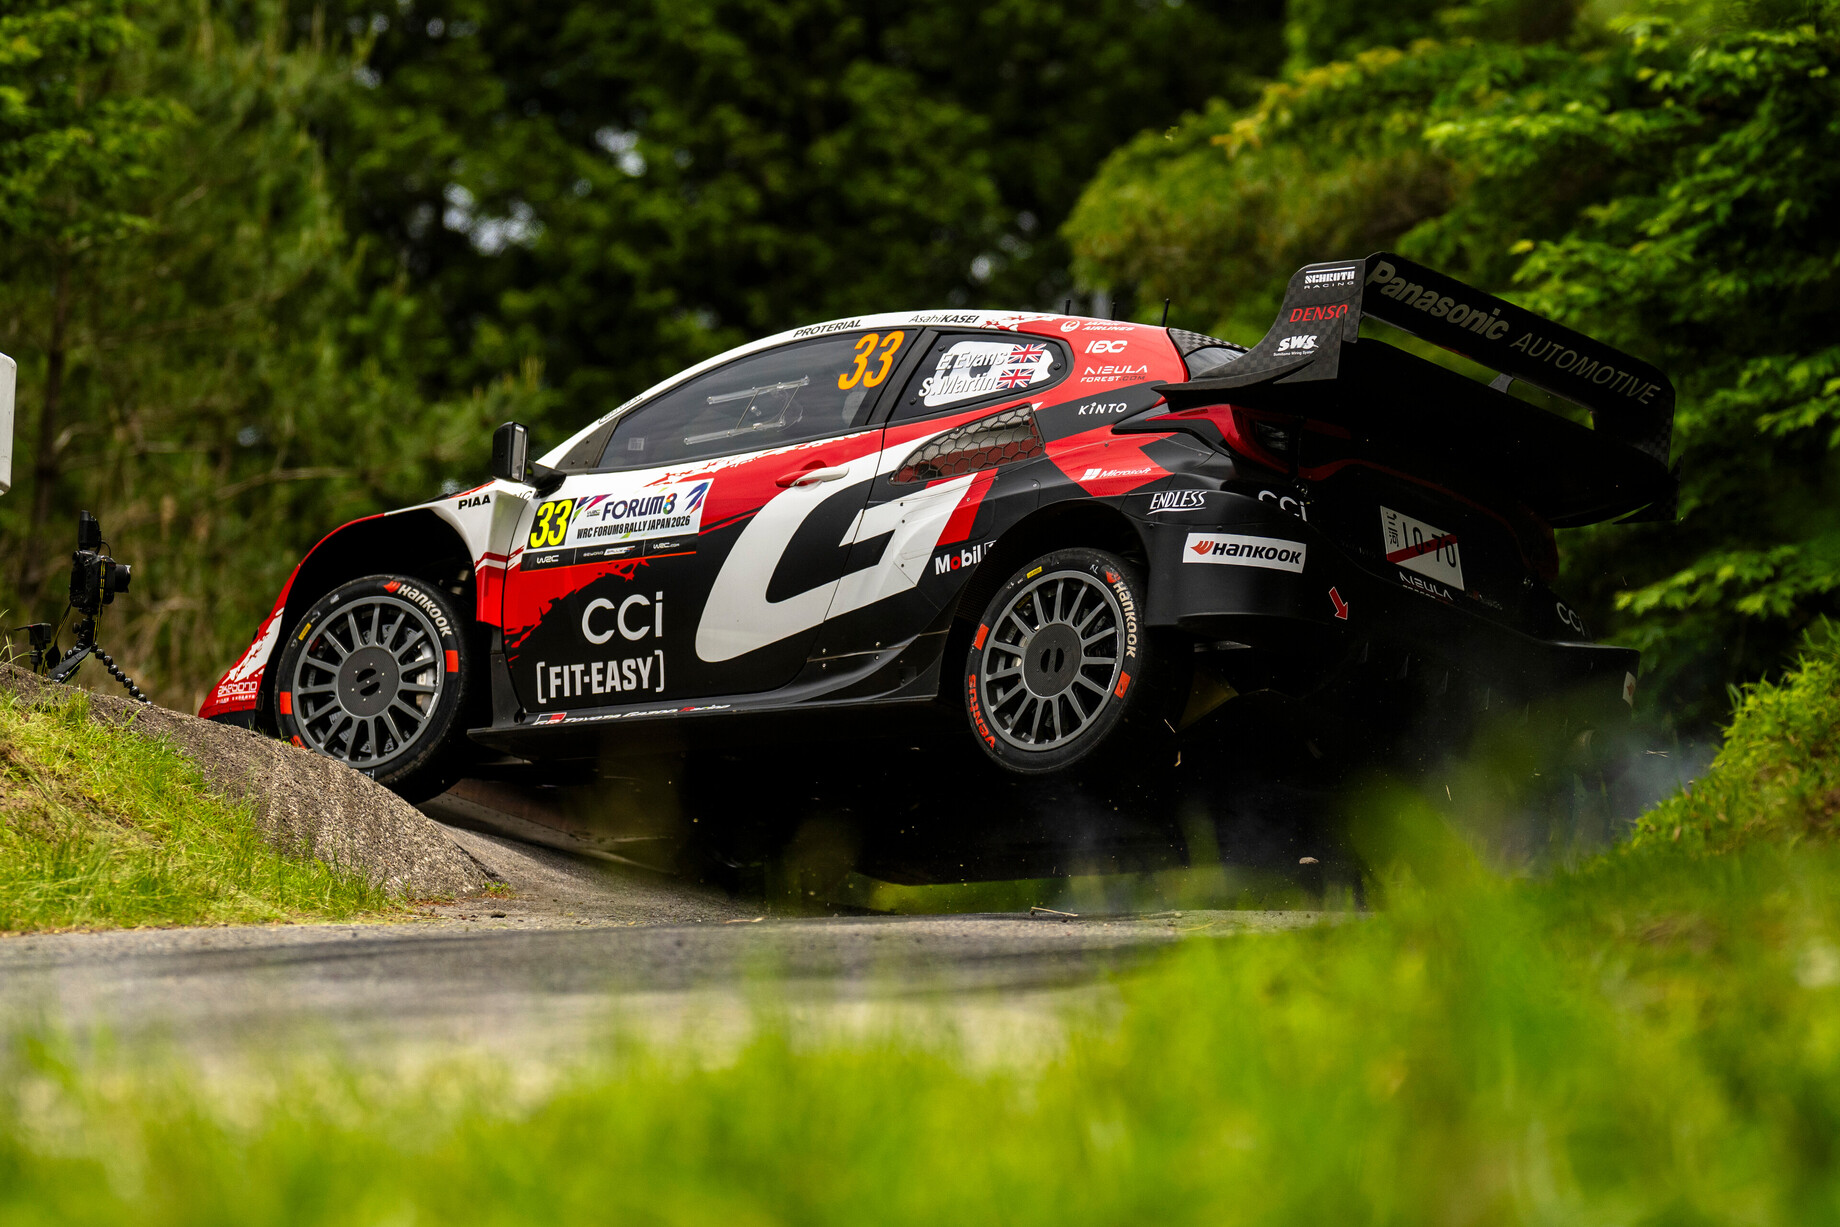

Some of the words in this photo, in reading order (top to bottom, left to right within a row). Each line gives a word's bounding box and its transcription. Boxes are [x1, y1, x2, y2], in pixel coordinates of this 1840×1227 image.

[1303, 281, 1354, 290] RACING
[1304, 270, 1356, 284] SCHROTH
[1289, 304, 1348, 323] DENSO
[793, 319, 862, 338] PROTERIAL
[1365, 260, 1510, 340] Panasonic
[1510, 332, 1661, 405] AUTOMOTIVE
[1277, 334, 1319, 352] SWS
[837, 330, 905, 390] 33
[1080, 375, 1146, 383] FOREST.COM
[1100, 467, 1152, 479] Microsoft
[458, 494, 491, 510] PIAA
[601, 492, 678, 521] FORUM8
[1149, 490, 1208, 510] ENDLESS
[529, 499, 573, 549] 33
[576, 527, 593, 540] WRC
[593, 523, 624, 538] FORUM8
[624, 520, 647, 534] RALLY
[646, 517, 671, 532] JAPAN
[671, 515, 691, 529] 2026
[1402, 521, 1457, 568] 10-70
[536, 554, 560, 565] WRC
[935, 544, 982, 576] Mobil
